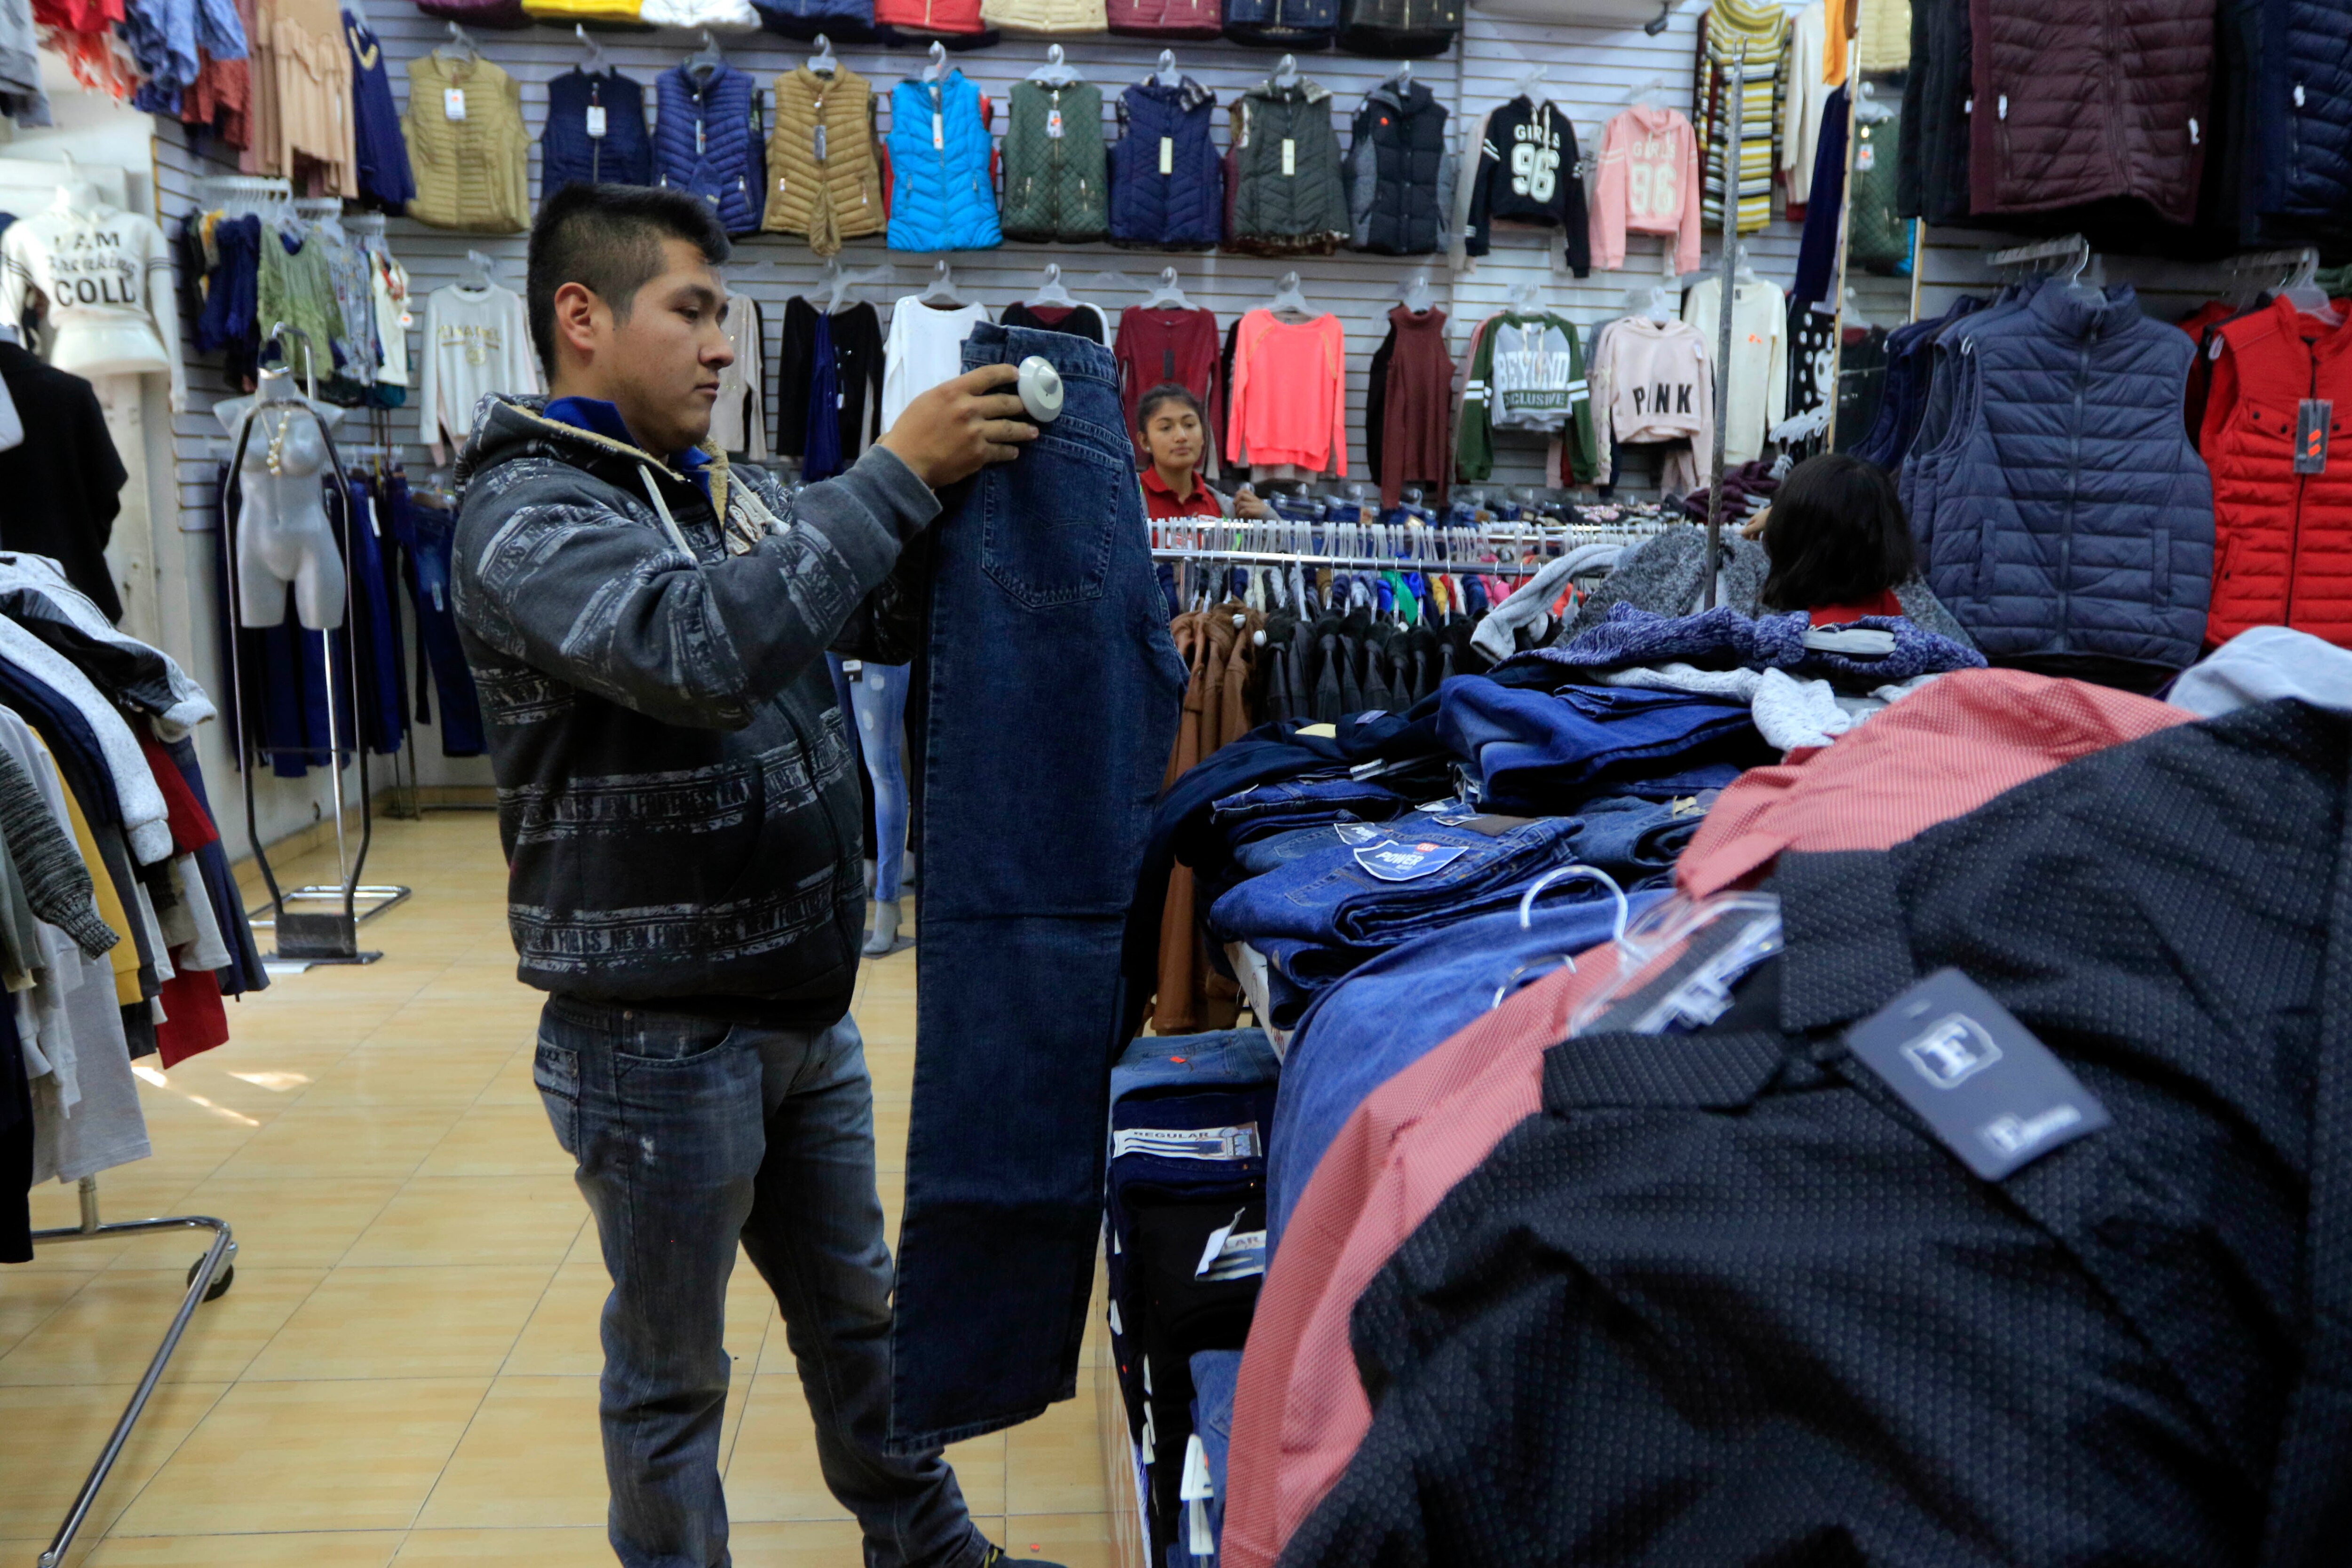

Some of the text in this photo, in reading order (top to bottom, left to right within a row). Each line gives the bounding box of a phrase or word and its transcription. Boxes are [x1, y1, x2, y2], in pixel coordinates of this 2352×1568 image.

[1513, 124, 1561, 150] GIRS
[1511, 143, 1561, 204] 96
[1631, 162, 1677, 215] 96
[74, 232, 120, 250] AM
[1496, 351, 1571, 390] BEYOND
[1375, 851, 1425, 867] POWER
[1133, 1131, 1209, 1139] REGULAR
